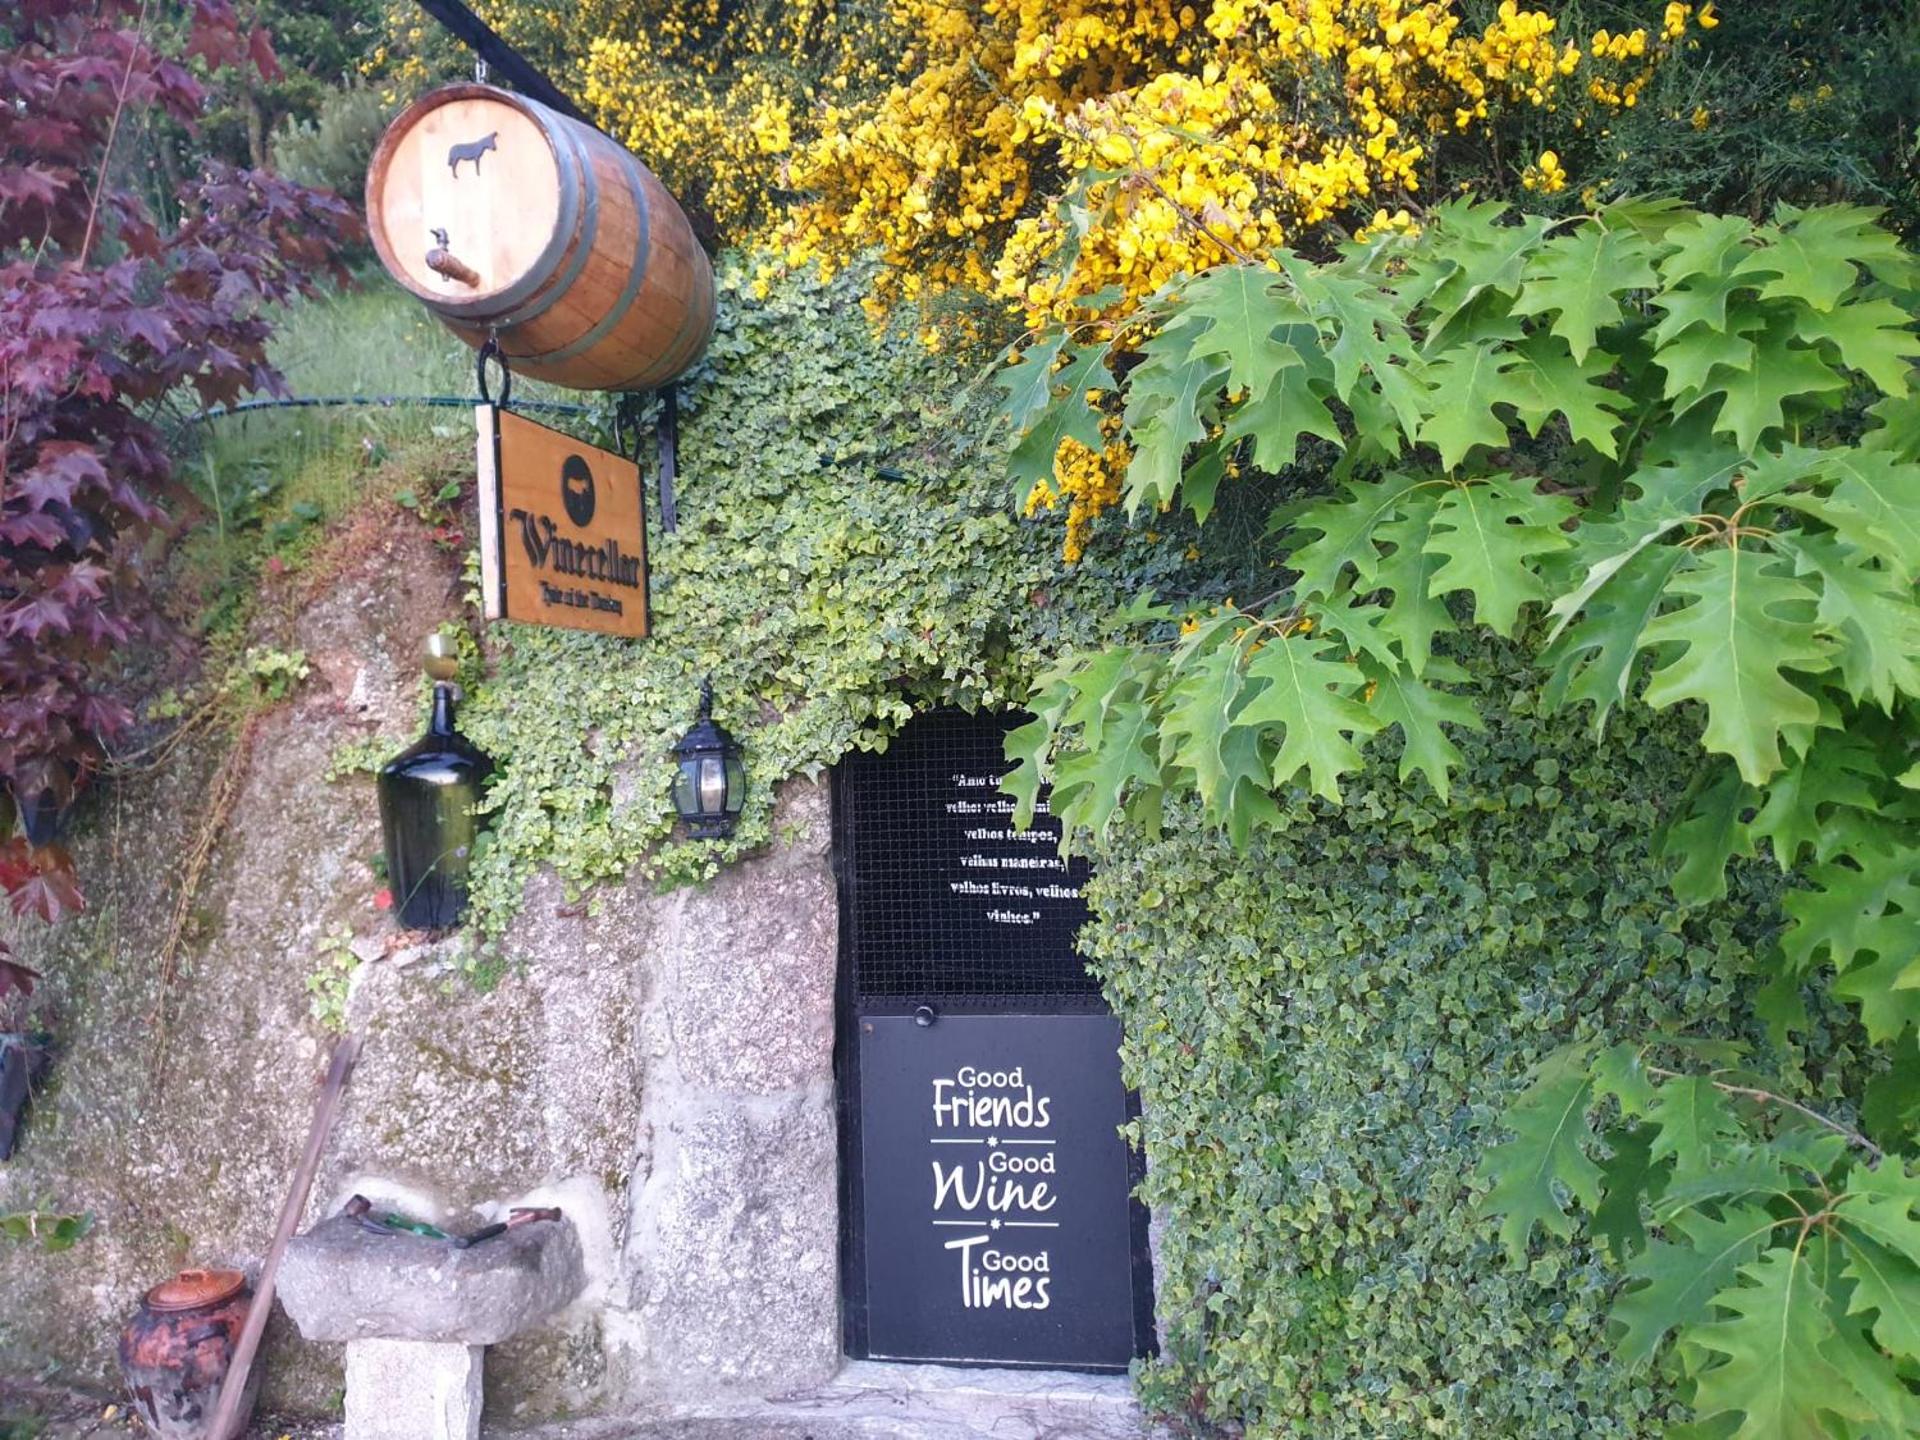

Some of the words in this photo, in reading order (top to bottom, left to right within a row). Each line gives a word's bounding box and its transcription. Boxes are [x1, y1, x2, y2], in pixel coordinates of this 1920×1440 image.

[984, 801, 1016, 813] velho
[965, 828, 1004, 841] velhos
[960, 855, 998, 868] velhas
[1001, 856, 1065, 872] maneiras,
[950, 881, 989, 895] velhos
[991, 882, 1033, 899] livros,
[1035, 885, 1078, 899] velhos
[957, 1066, 1025, 1088] Good
[932, 1078, 1051, 1127] Friends
[988, 1151, 1056, 1173] Good
[932, 1161, 1057, 1212] Wine
[982, 1249, 1050, 1272] Good
[944, 1234, 1051, 1310] Times
